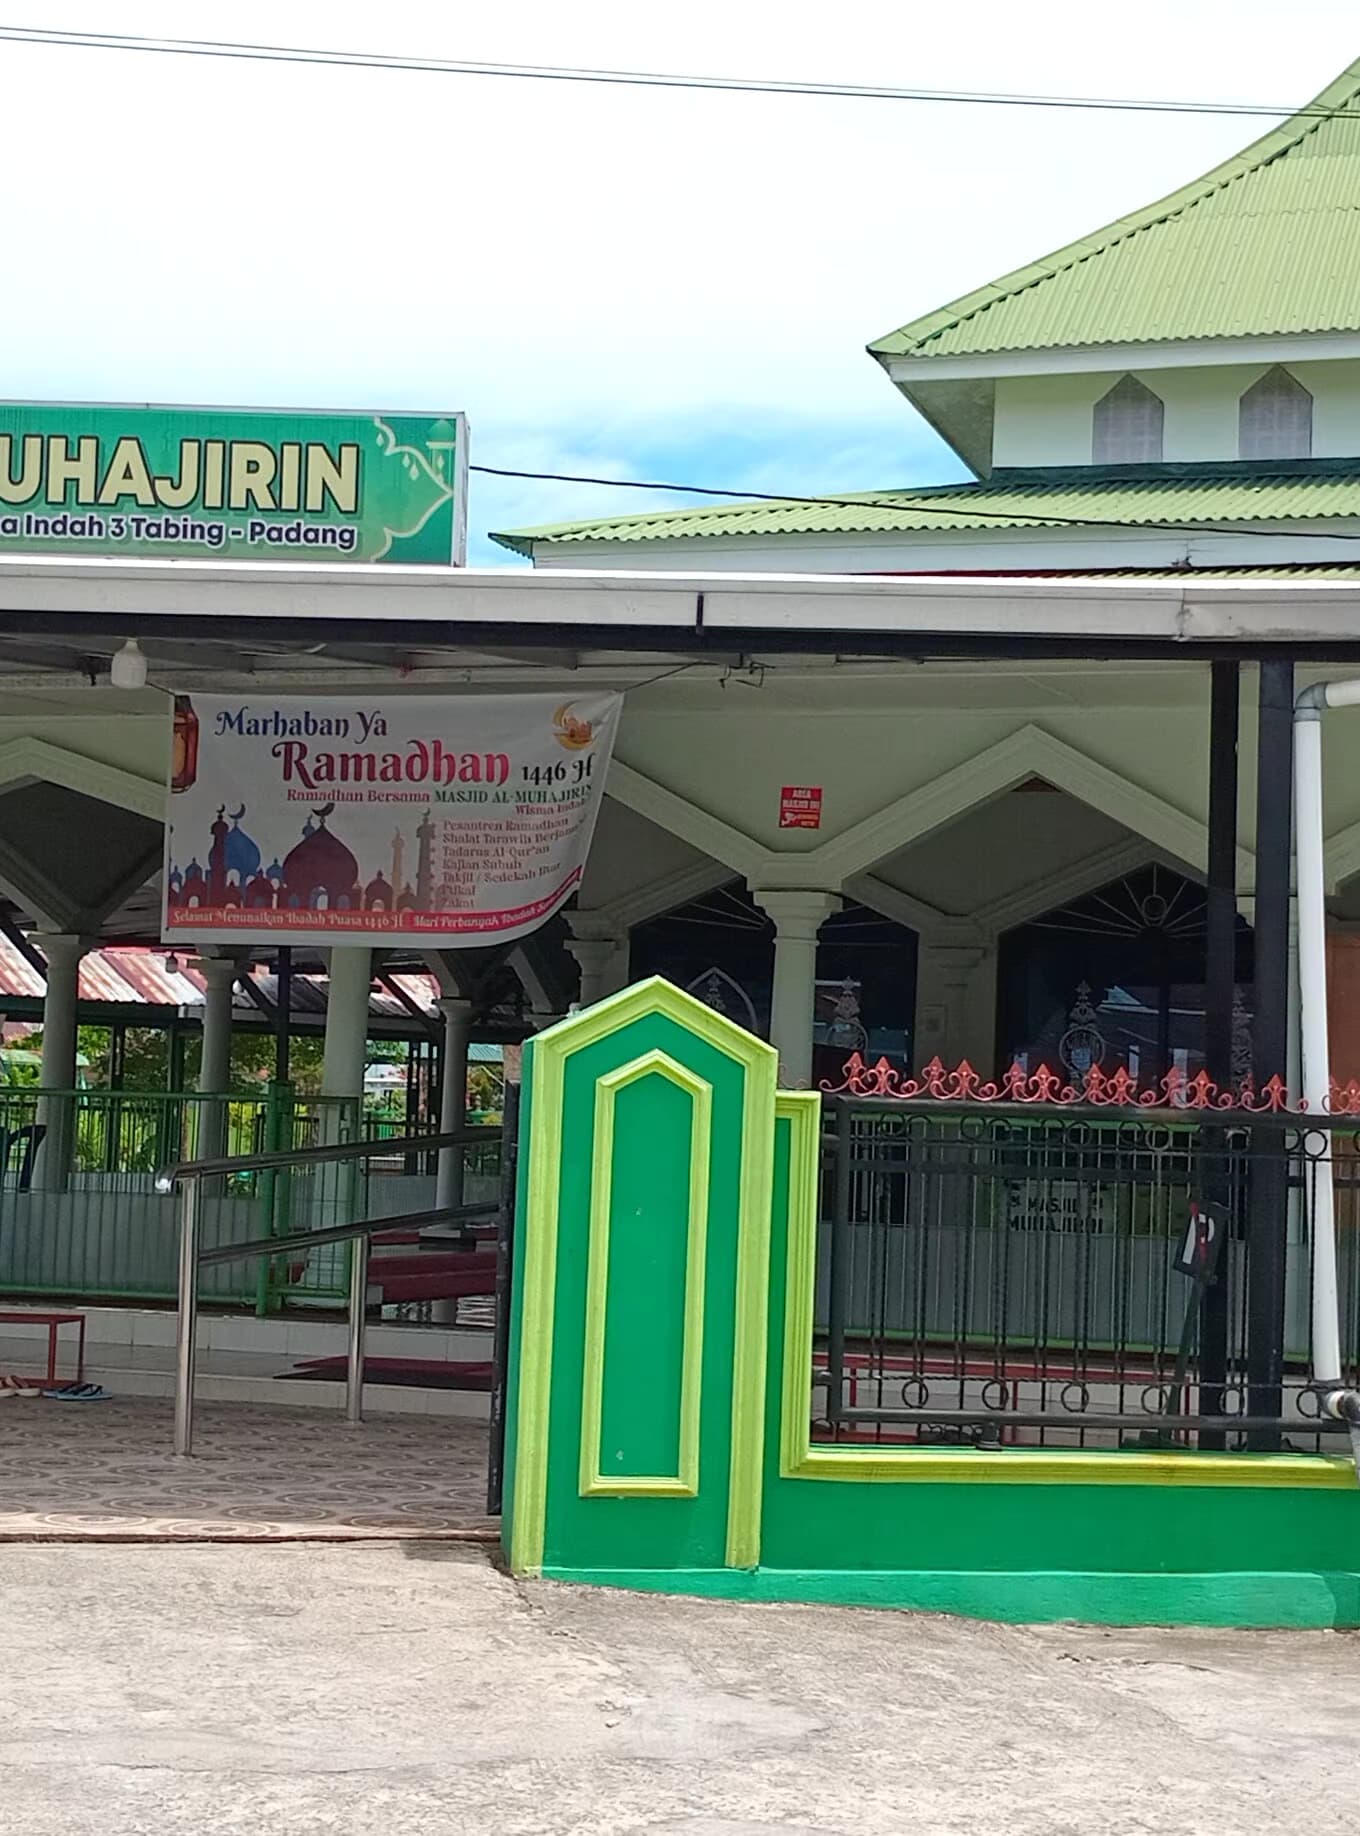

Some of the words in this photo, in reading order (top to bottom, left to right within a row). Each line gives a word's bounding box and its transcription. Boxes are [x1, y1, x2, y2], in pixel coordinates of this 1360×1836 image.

[25, 513, 103, 537] Indah
[110, 517, 123, 538] 3
[132, 518, 225, 546] Tabing
[249, 521, 356, 548] Padang
[214, 706, 349, 738] Marhaban
[354, 710, 388, 744] Ya
[271, 739, 510, 789] Ramadhan
[522, 760, 567, 786] 1446
[287, 789, 363, 802] Ramadhan
[368, 790, 430, 803] Bersama
[435, 789, 488, 803] MASJID
[443, 820, 502, 831] Pesantren
[506, 818, 568, 831] Ramadhan
[442, 846, 489, 857] Tadarus
[173, 909, 213, 924] Selamat
[215, 910, 284, 926] Menunaikan
[286, 911, 325, 926] Ibadah
[328, 912, 362, 925] Puasa
